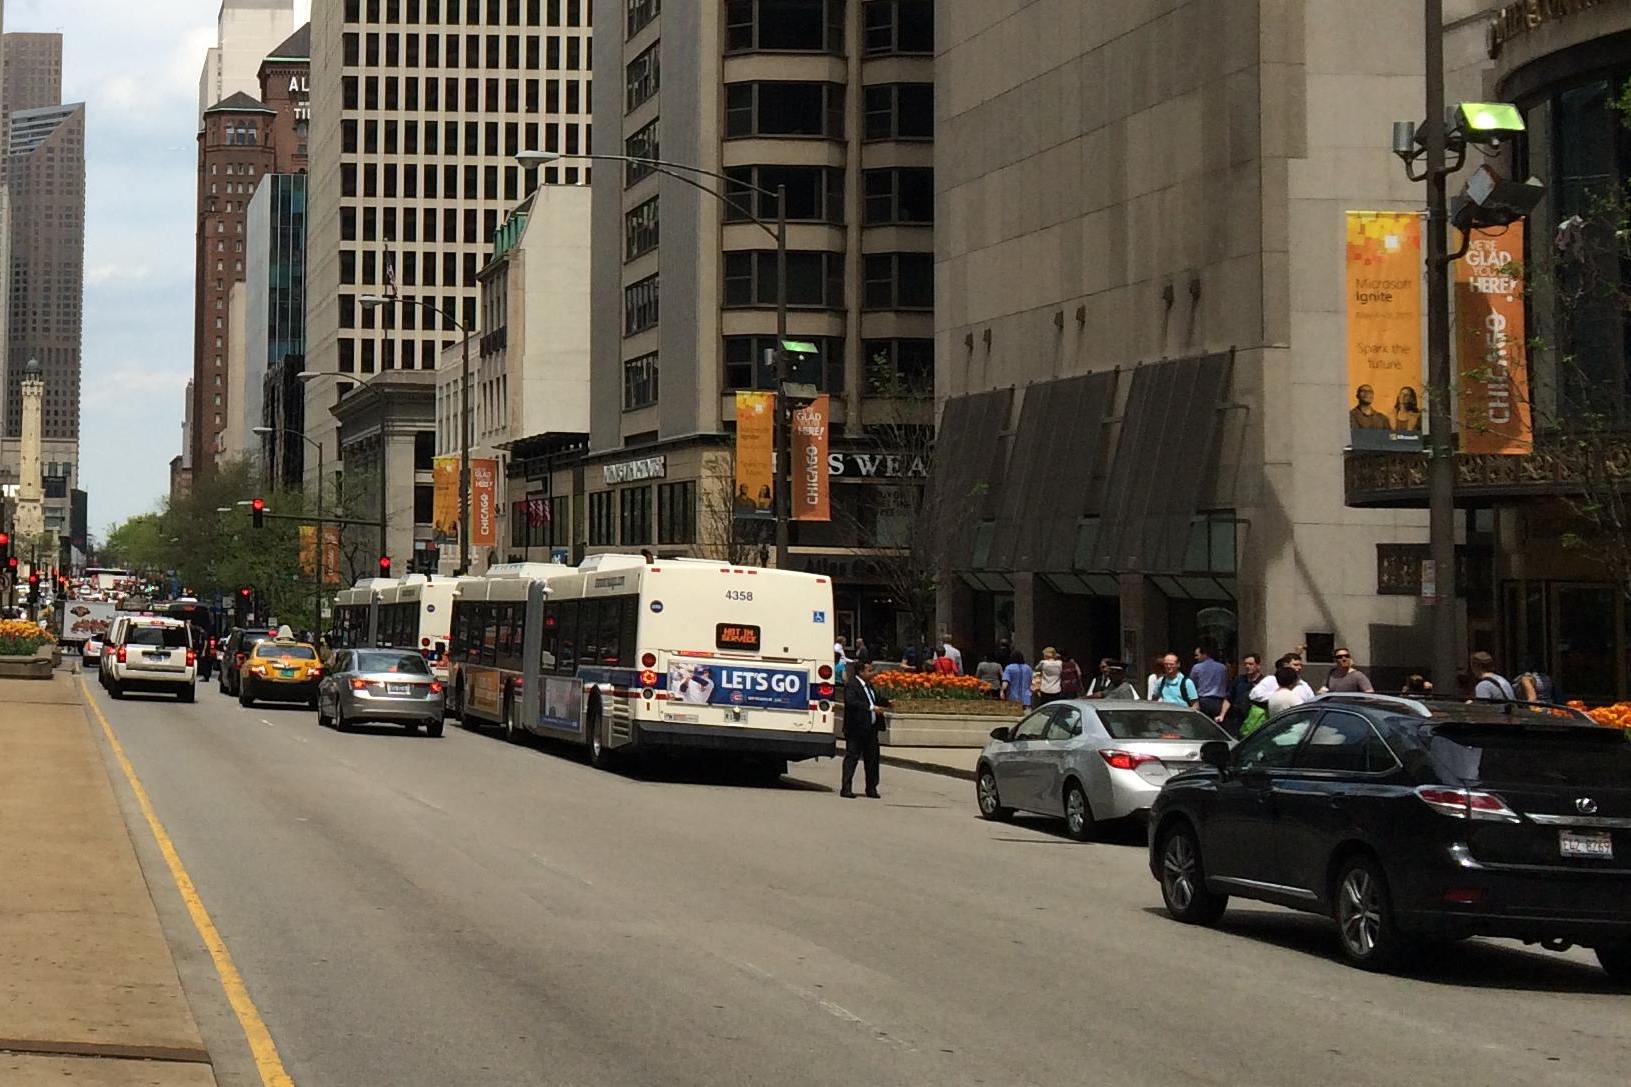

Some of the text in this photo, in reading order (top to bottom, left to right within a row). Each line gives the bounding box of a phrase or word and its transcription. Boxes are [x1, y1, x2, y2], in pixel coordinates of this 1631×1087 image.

[1465, 250, 1512, 267] GLAD
[1355, 278, 1412, 290] Microsoft
[1469, 276, 1519, 302] HERE!
[1355, 290, 1393, 305] Ignite
[796, 412, 822, 421] GLAD
[806, 444, 819, 505] CHICAGO
[480, 492, 489, 536] CHICAGO
[724, 589, 754, 602] 4358
[721, 669, 801, 693] LET'S GO
